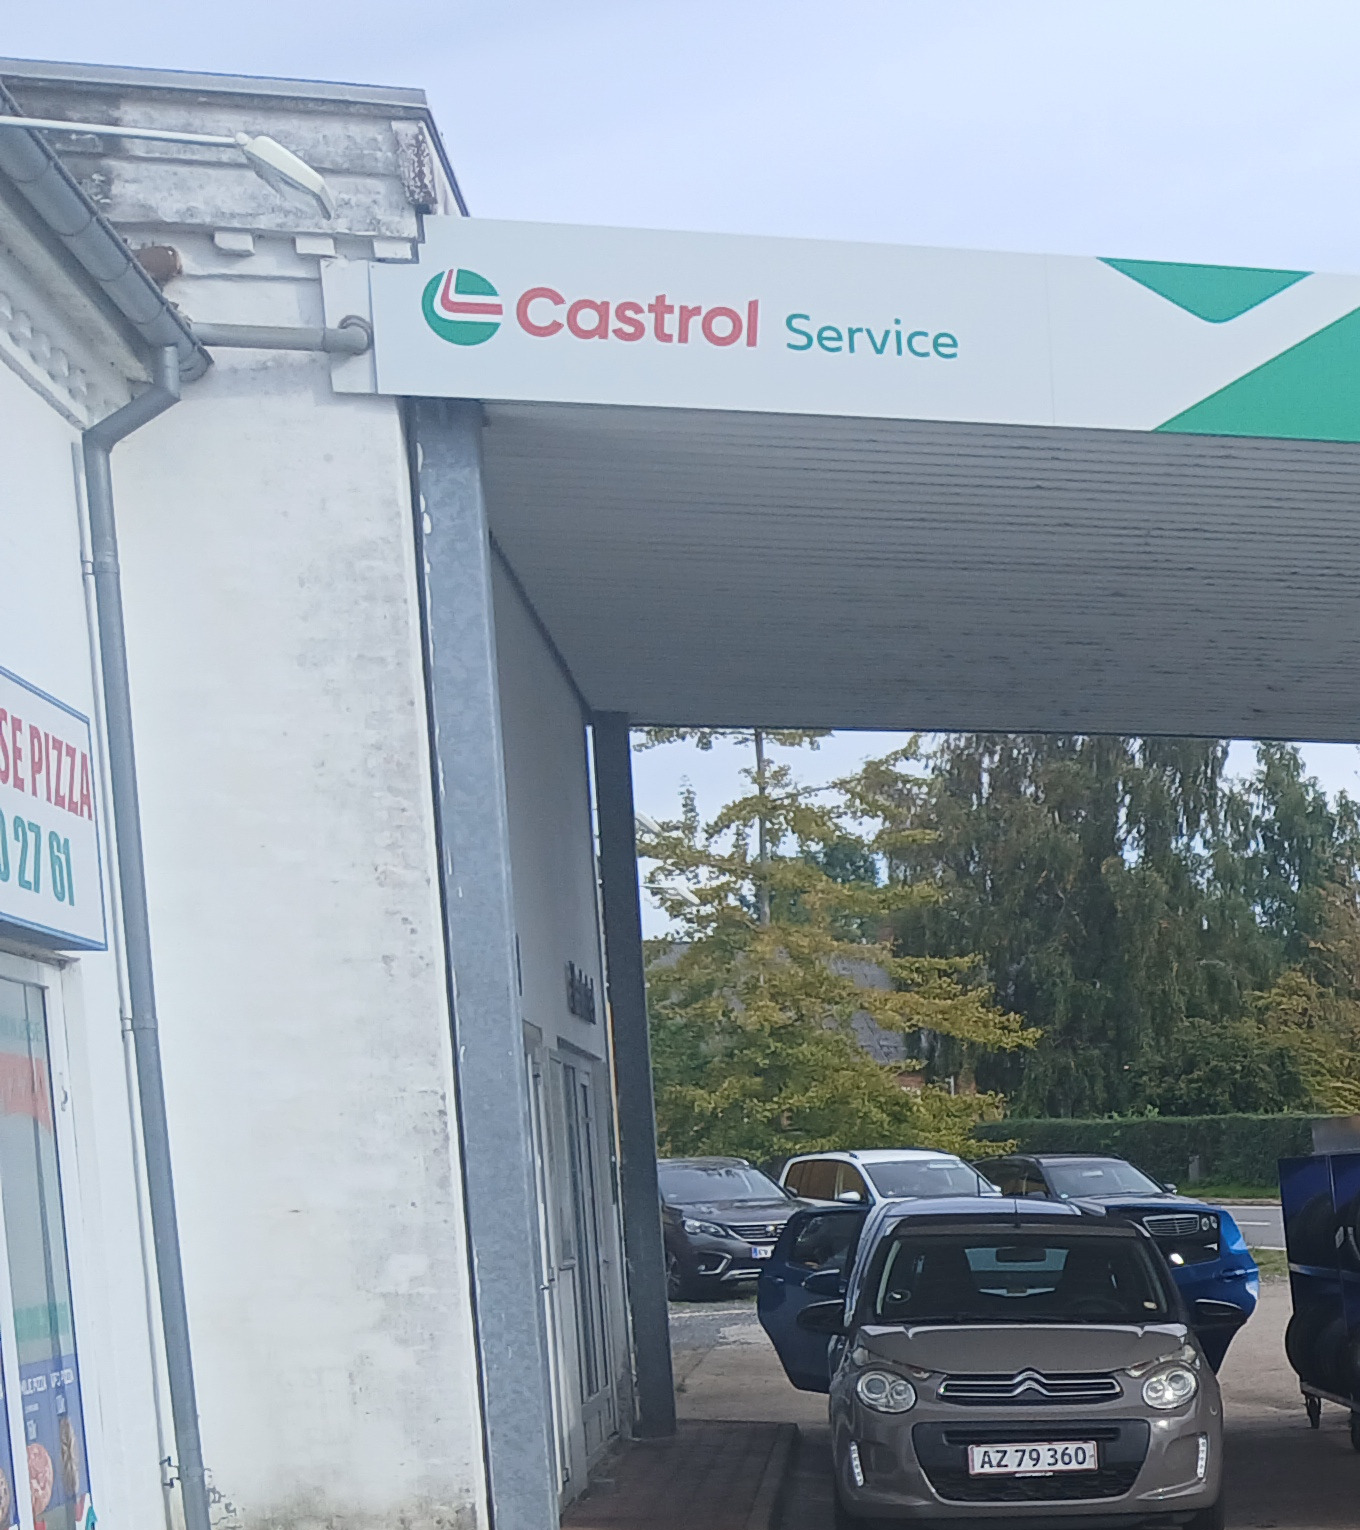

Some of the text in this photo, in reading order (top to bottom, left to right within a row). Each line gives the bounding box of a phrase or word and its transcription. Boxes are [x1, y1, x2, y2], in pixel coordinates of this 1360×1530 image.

[515, 286, 958, 359] Castrol Service
[29, 723, 93, 821] PIZZA
[13, 815, 41, 894] 27
[49, 830, 75, 906] 61
[980, 1446, 1087, 1468] AZ 79 360
